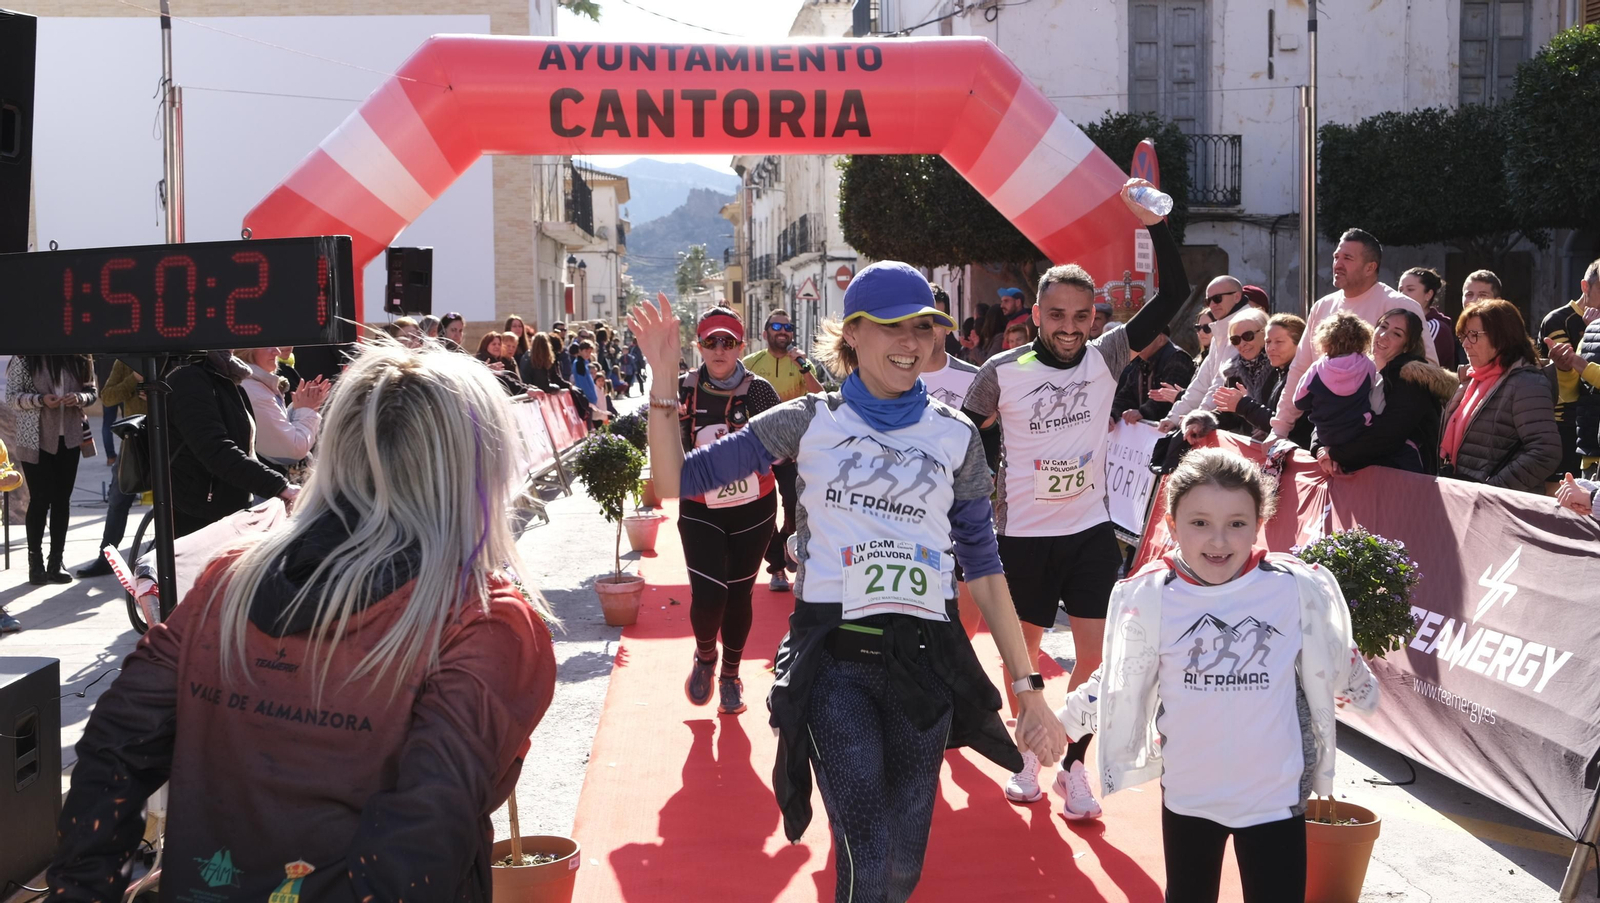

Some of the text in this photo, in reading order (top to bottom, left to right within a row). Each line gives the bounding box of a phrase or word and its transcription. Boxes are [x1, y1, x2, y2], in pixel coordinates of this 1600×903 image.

[538, 44, 884, 72] AYUNTAMIENTO
[549, 87, 872, 138] CANTORIA
[717, 478, 749, 499] 290
[1048, 470, 1085, 493] 278
[853, 555, 865, 565] LA
[867, 549, 912, 561] PÓLVORA
[855, 539, 895, 553] IV CxM
[864, 563, 928, 596] 279
[227, 693, 250, 711] DE
[253, 700, 373, 732] ALMANZORA
[1413, 677, 1498, 725] www.teamergy.es
